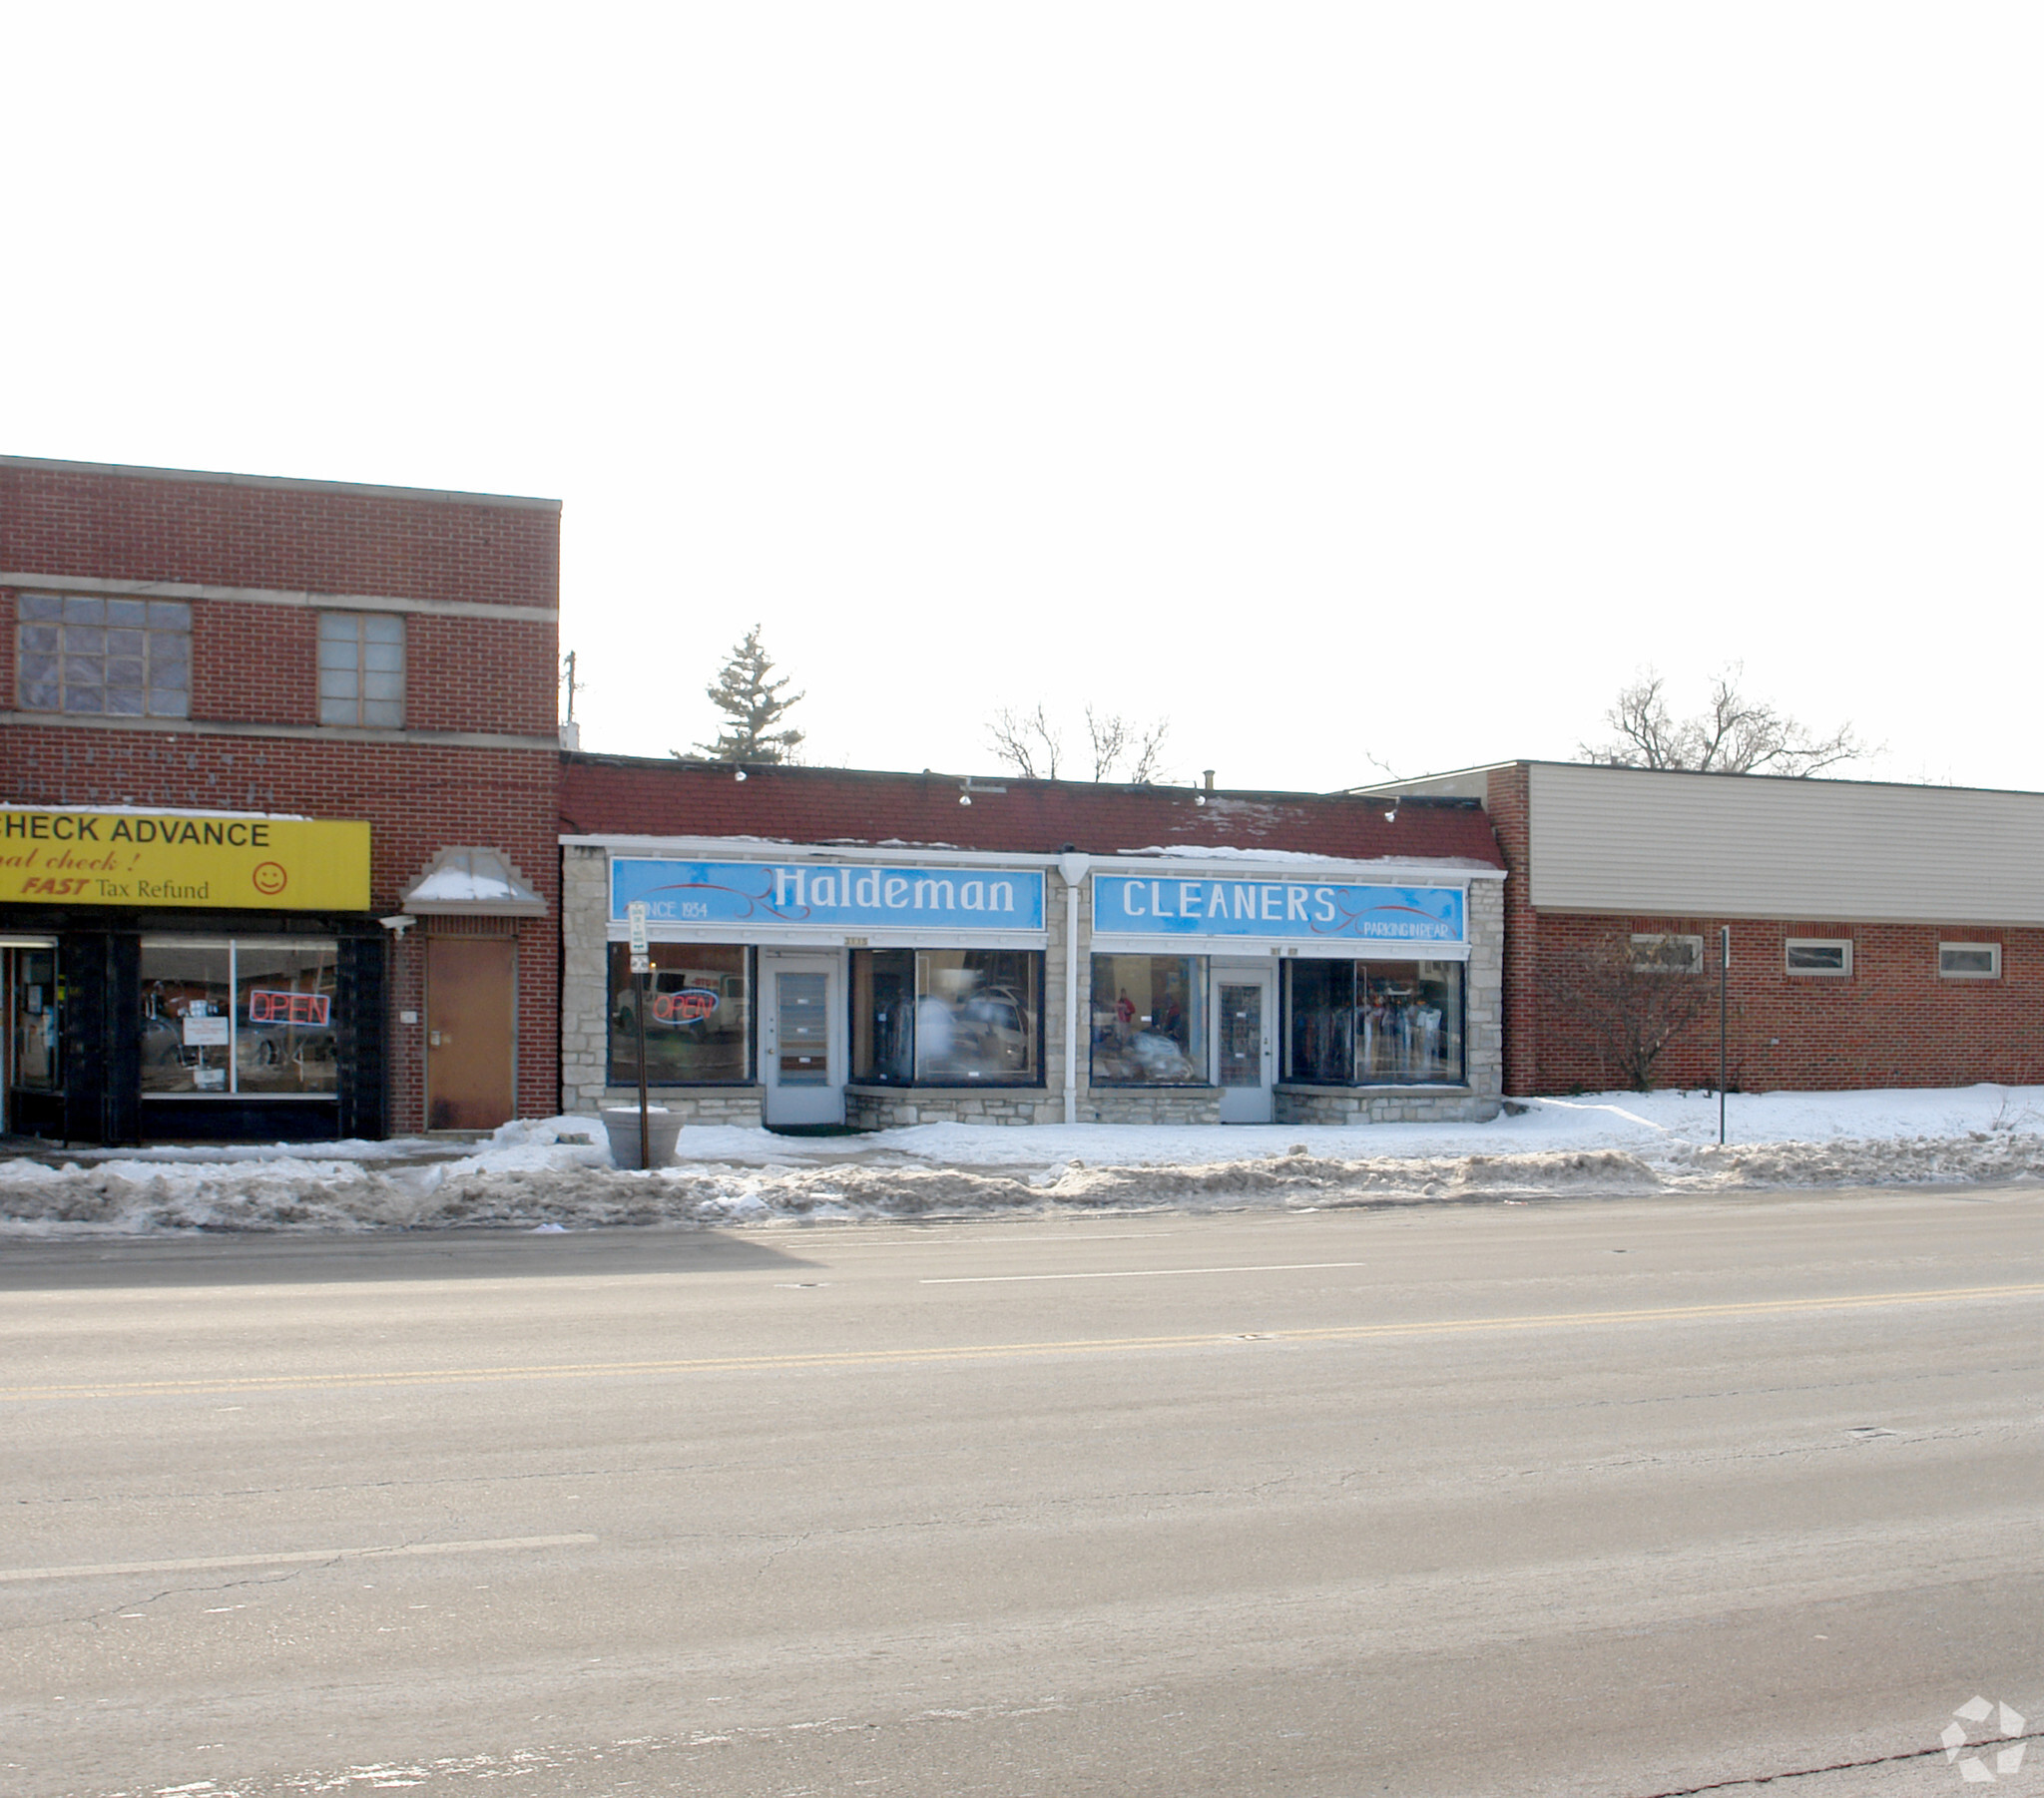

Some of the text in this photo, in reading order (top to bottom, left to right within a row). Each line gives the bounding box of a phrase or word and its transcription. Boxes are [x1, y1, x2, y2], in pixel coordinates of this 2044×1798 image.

[0, 814, 270, 847] HECK ADVANCE
[45, 849, 118, 871] check
[20, 877, 210, 899] FAST Tax Refund
[774, 867, 1015, 912] Haldeman
[646, 901, 677, 918] NCE
[1123, 880, 1336, 922] CLEANERS
[1363, 921, 1409, 937] PARKING
[253, 993, 328, 1025] OPEN
[653, 995, 714, 1019] OPEN
